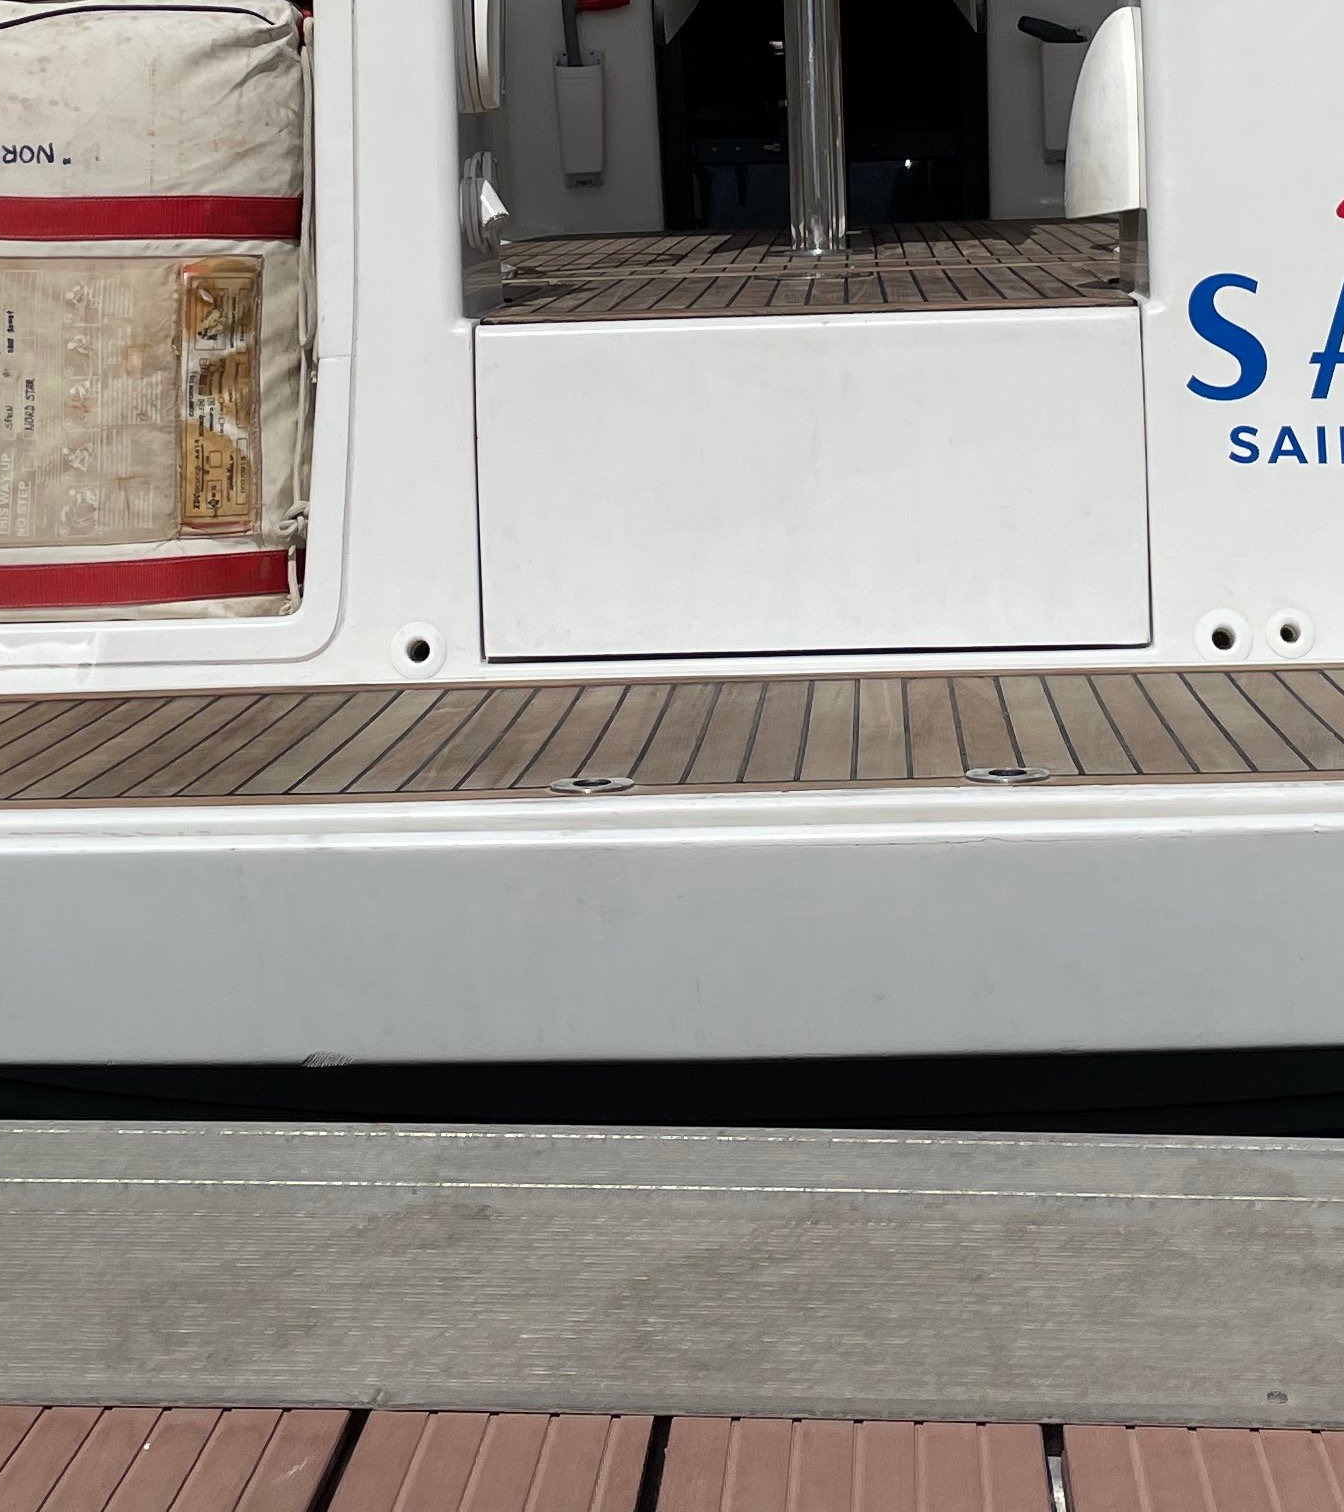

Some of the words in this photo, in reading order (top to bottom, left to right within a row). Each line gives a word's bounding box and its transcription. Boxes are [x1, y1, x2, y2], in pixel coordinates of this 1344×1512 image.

[1, 453, 11, 471] UP
[0, 475, 11, 506] WAY
[17, 481, 29, 516] STEP
[16, 518, 27, 537] NO
